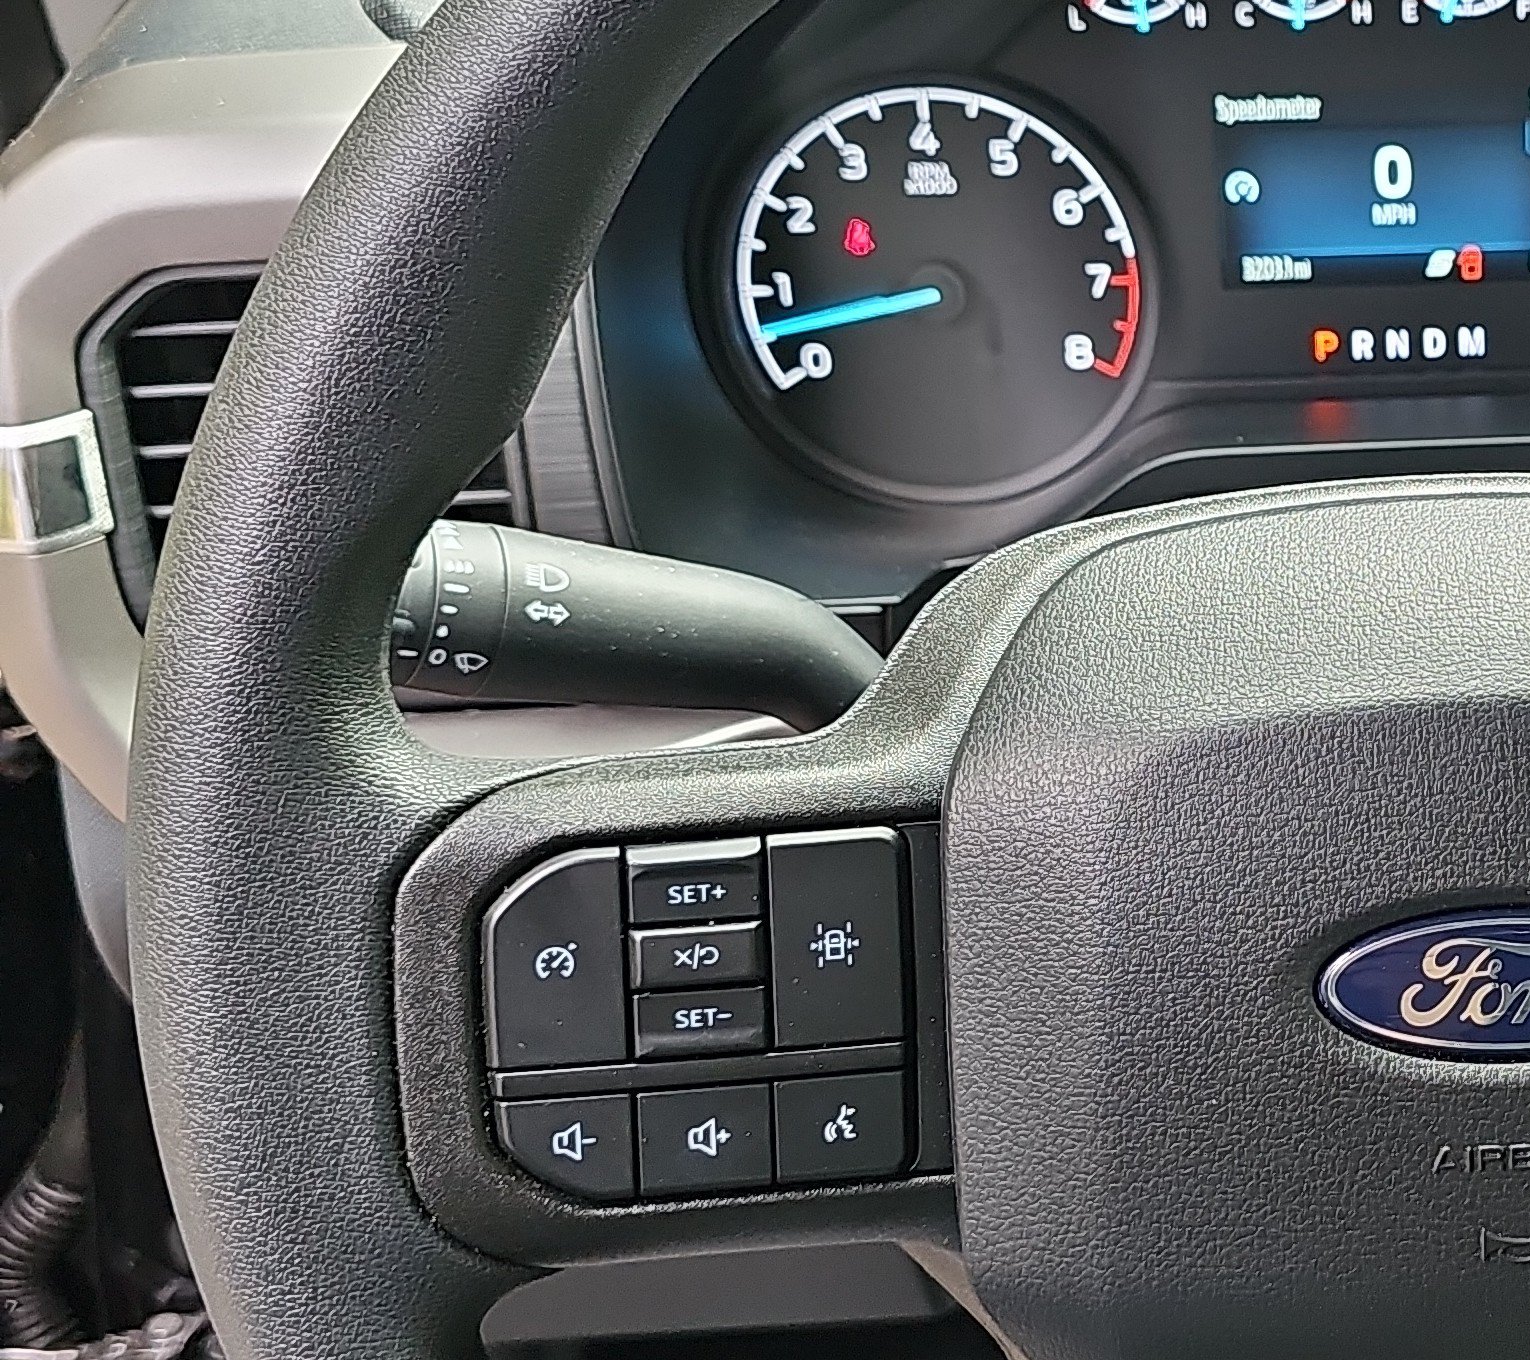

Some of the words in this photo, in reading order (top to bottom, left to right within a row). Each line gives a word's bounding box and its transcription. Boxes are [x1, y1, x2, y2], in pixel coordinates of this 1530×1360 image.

[1067, 3, 1087, 31] L
[1185, 1, 1207, 29] H
[1234, 0, 1255, 28] C
[1214, 94, 1323, 126] Speedometer
[909, 123, 941, 157] 4
[988, 139, 1018, 176] 5
[839, 144, 867, 180] 3
[1373, 144, 1413, 200] 0
[787, 196, 815, 233] 2
[1052, 189, 1084, 225] 6
[1372, 203, 1416, 227] MPH
[772, 271, 793, 307] 1
[1084, 262, 1112, 298] 7
[800, 343, 832, 378] 0
[1064, 334, 1094, 371] 8
[1314, 329, 1339, 362] P
[1351, 329, 1375, 361] R
[1385, 328, 1411, 360] N
[1422, 327, 1447, 359] D
[1458, 325, 1486, 357] M
